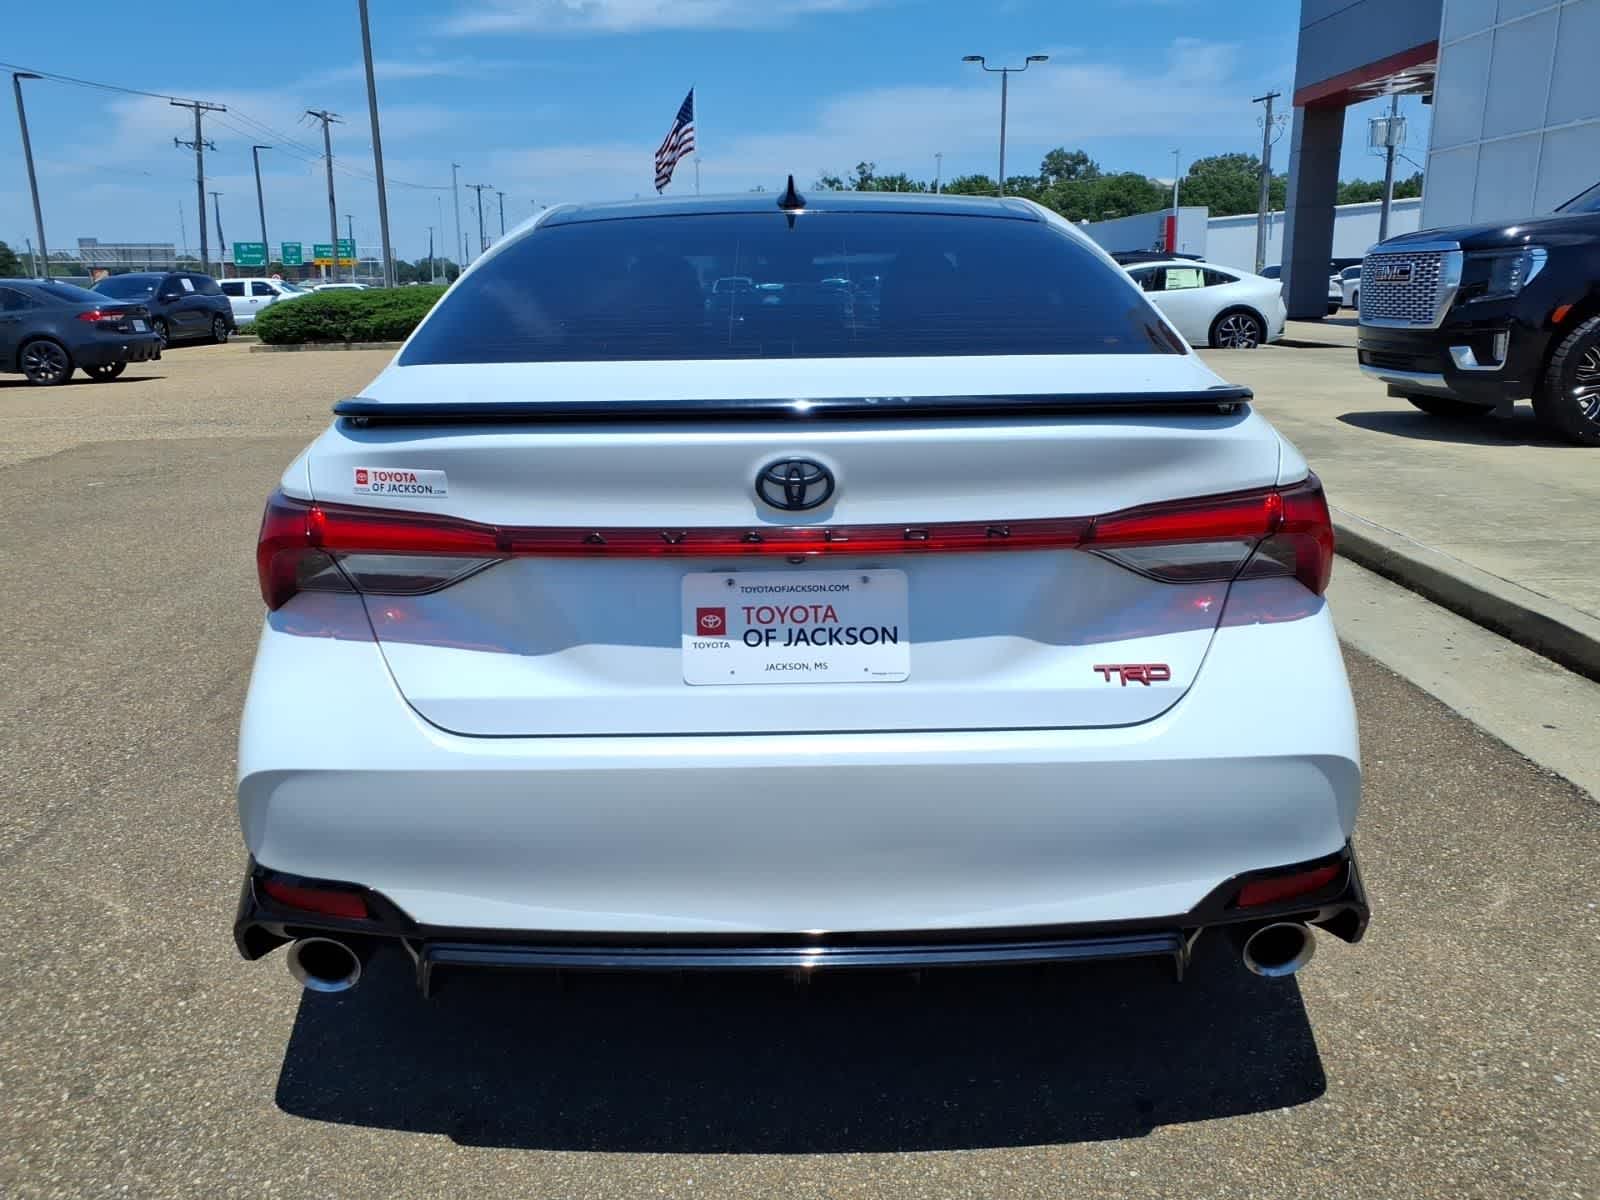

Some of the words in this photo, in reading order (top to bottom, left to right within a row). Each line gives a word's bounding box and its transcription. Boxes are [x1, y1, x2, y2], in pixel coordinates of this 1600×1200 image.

[1375, 264, 1411, 281] GMC
[372, 472, 417, 483] TOYOTA
[372, 483, 385, 492] OF
[581, 526, 1011, 545] AVALON
[740, 584, 850, 594] TOYOTAOFJACKSON.COM
[741, 605, 839, 625] TOYOTA
[743, 628, 777, 648] OF
[783, 626, 898, 647] JACKSON
[693, 641, 731, 650] TOYOTA
[764, 662, 812, 672] JACKSON,
[814, 662, 829, 671] MS
[1093, 663, 1171, 687] TRD
